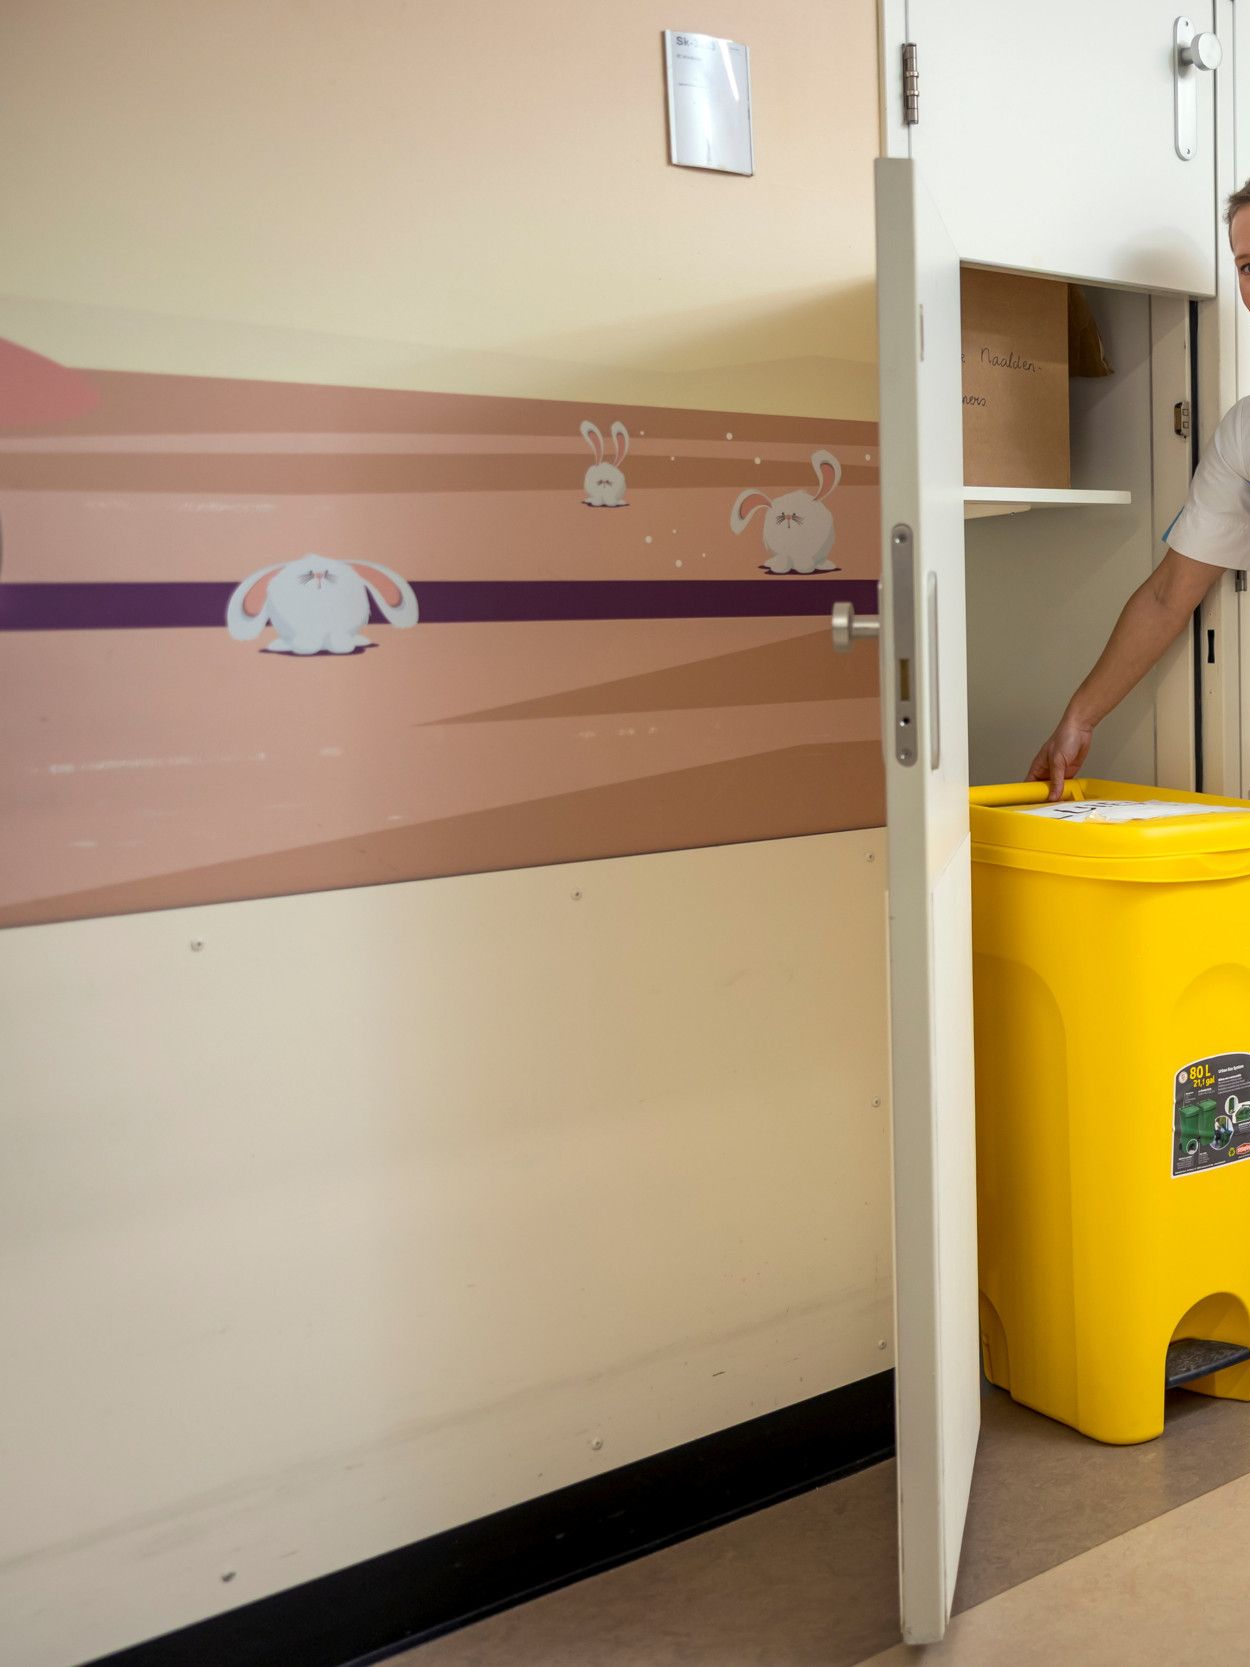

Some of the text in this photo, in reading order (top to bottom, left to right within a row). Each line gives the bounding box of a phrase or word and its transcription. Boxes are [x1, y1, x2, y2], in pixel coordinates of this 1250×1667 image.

[962, 395, 987, 407] ners
[1190, 1066, 1203, 1080] 80
[1205, 1064, 1211, 1077] L
[1205, 1075, 1216, 1087] gal
